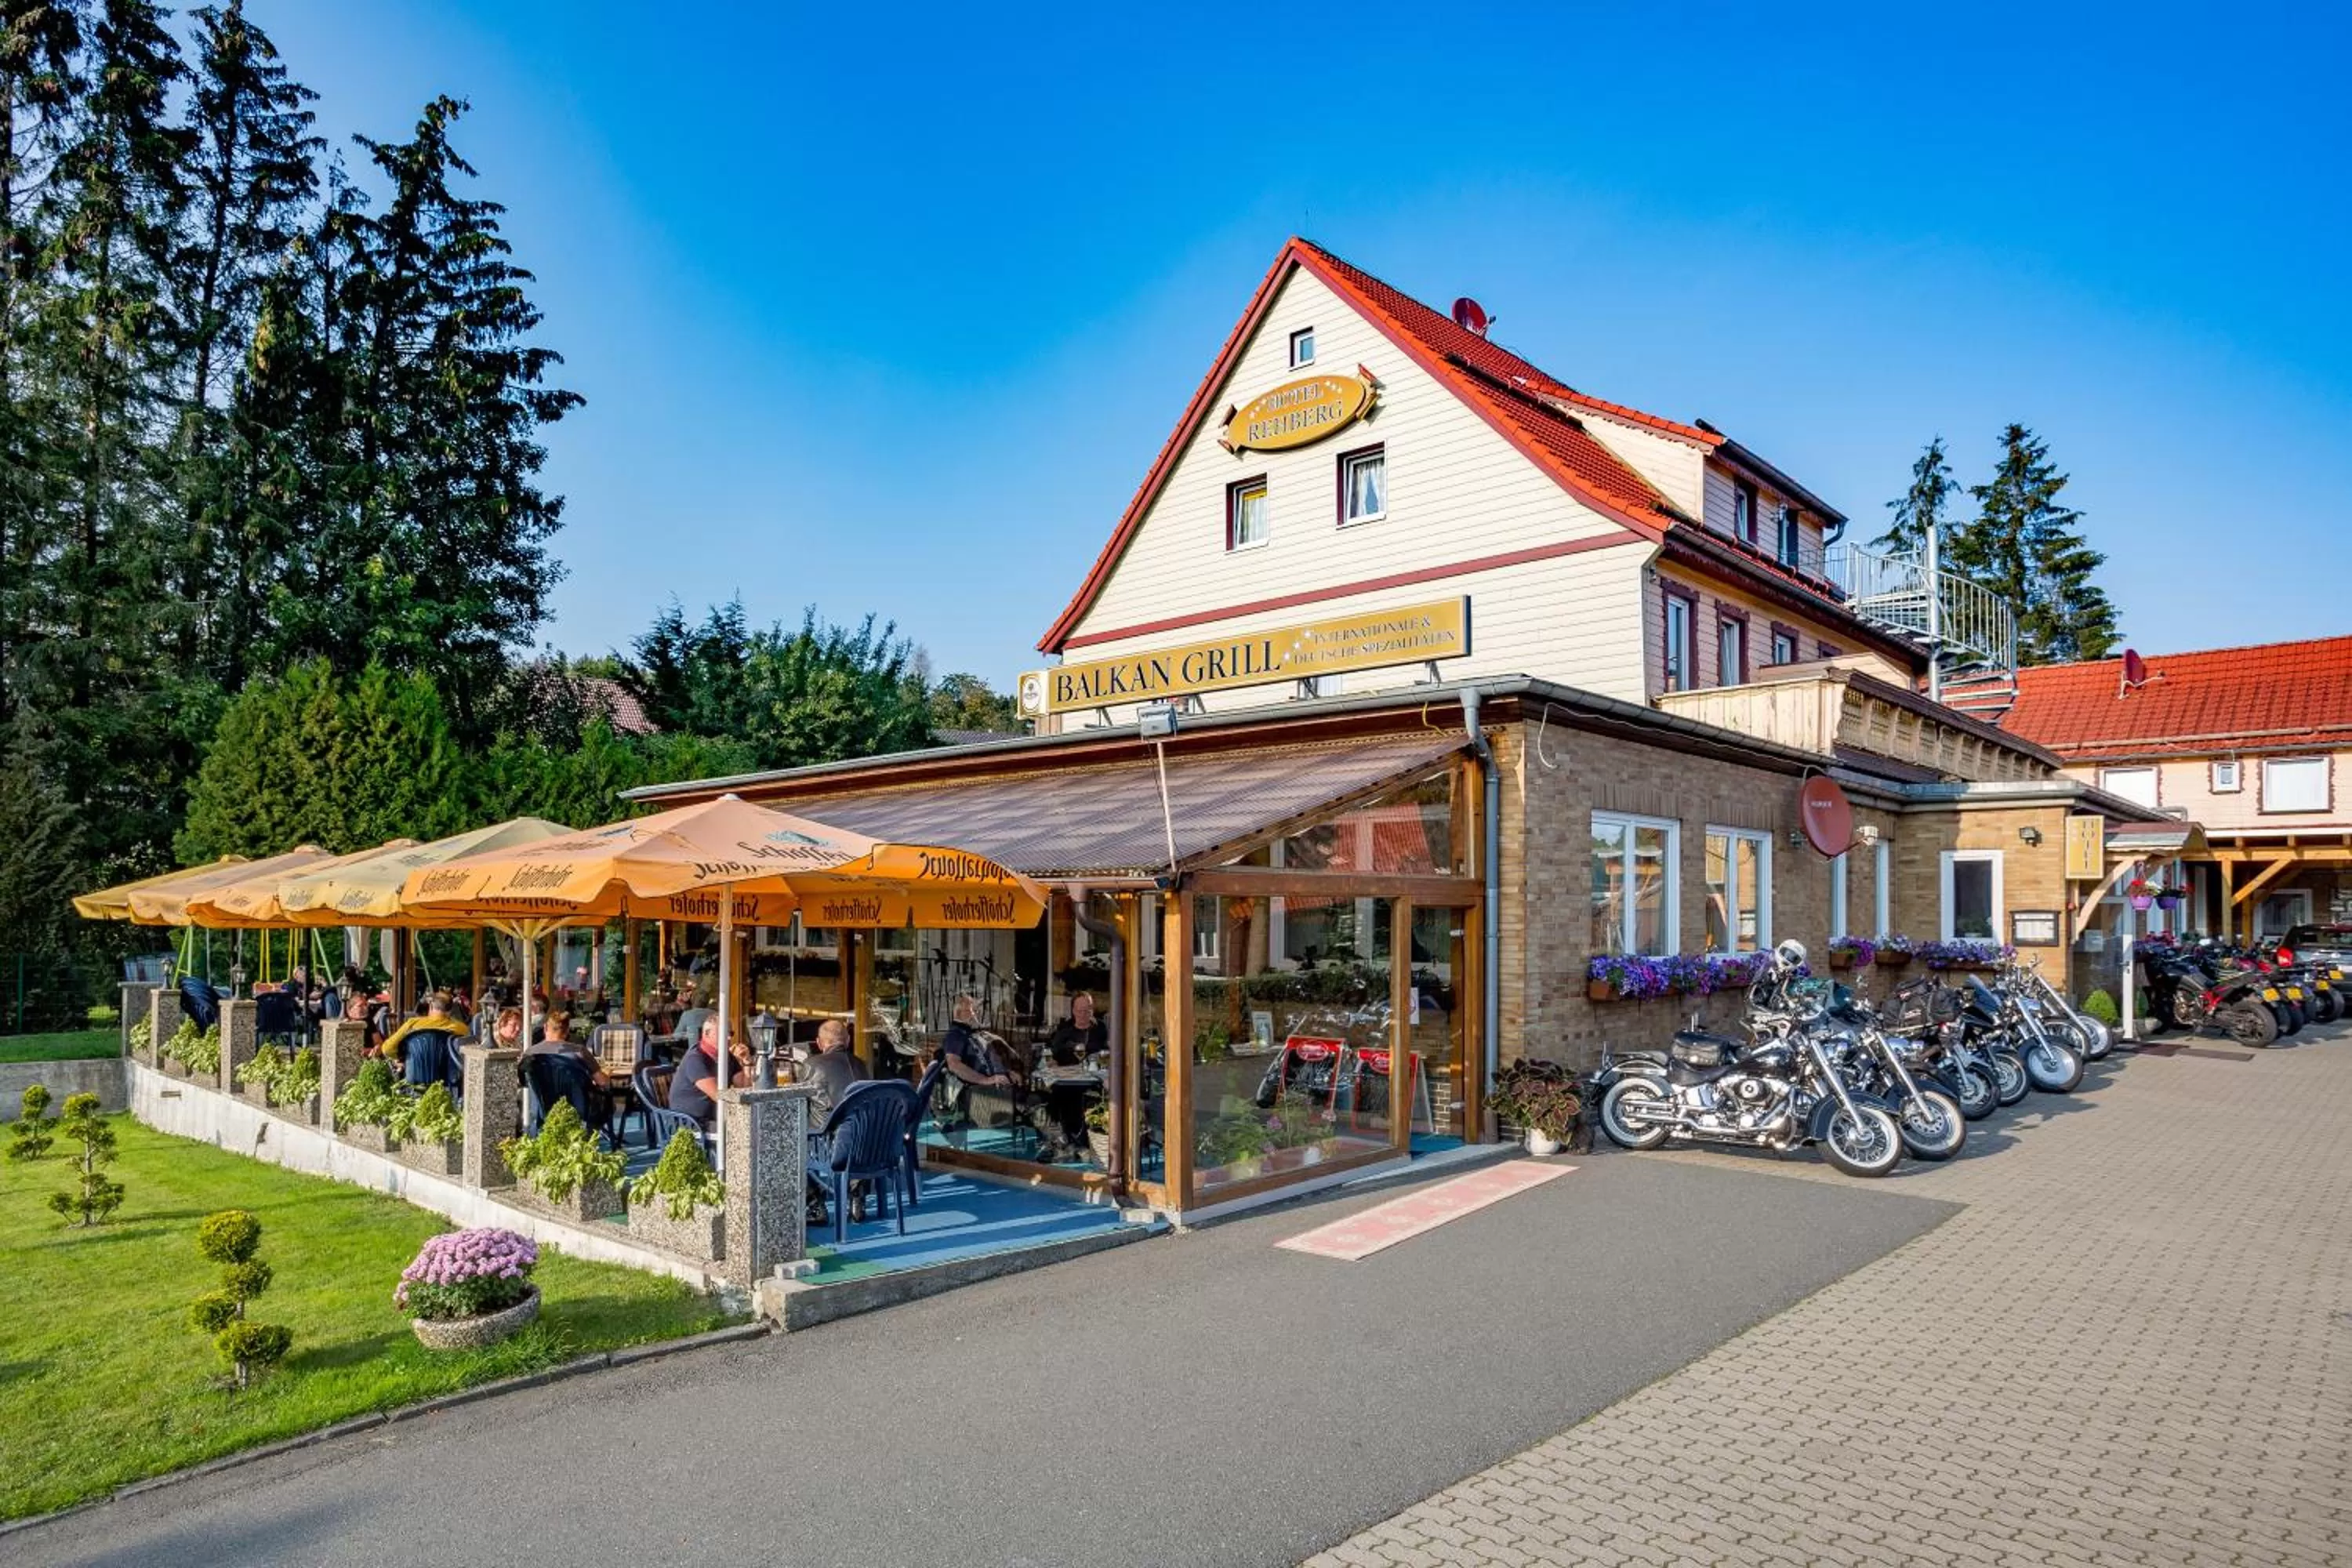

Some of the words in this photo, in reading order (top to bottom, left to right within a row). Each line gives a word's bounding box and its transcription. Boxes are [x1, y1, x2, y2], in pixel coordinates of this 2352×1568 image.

[1267, 384, 1323, 412] HOTEL
[1248, 400, 1343, 442] REHBERG
[1314, 617, 1419, 645] INTERNATIONALE
[1421, 614, 1432, 628] &
[1294, 646, 1359, 665] DEUTSCHE
[1056, 656, 1171, 703] BALKAN
[1181, 640, 1280, 684] GRILL
